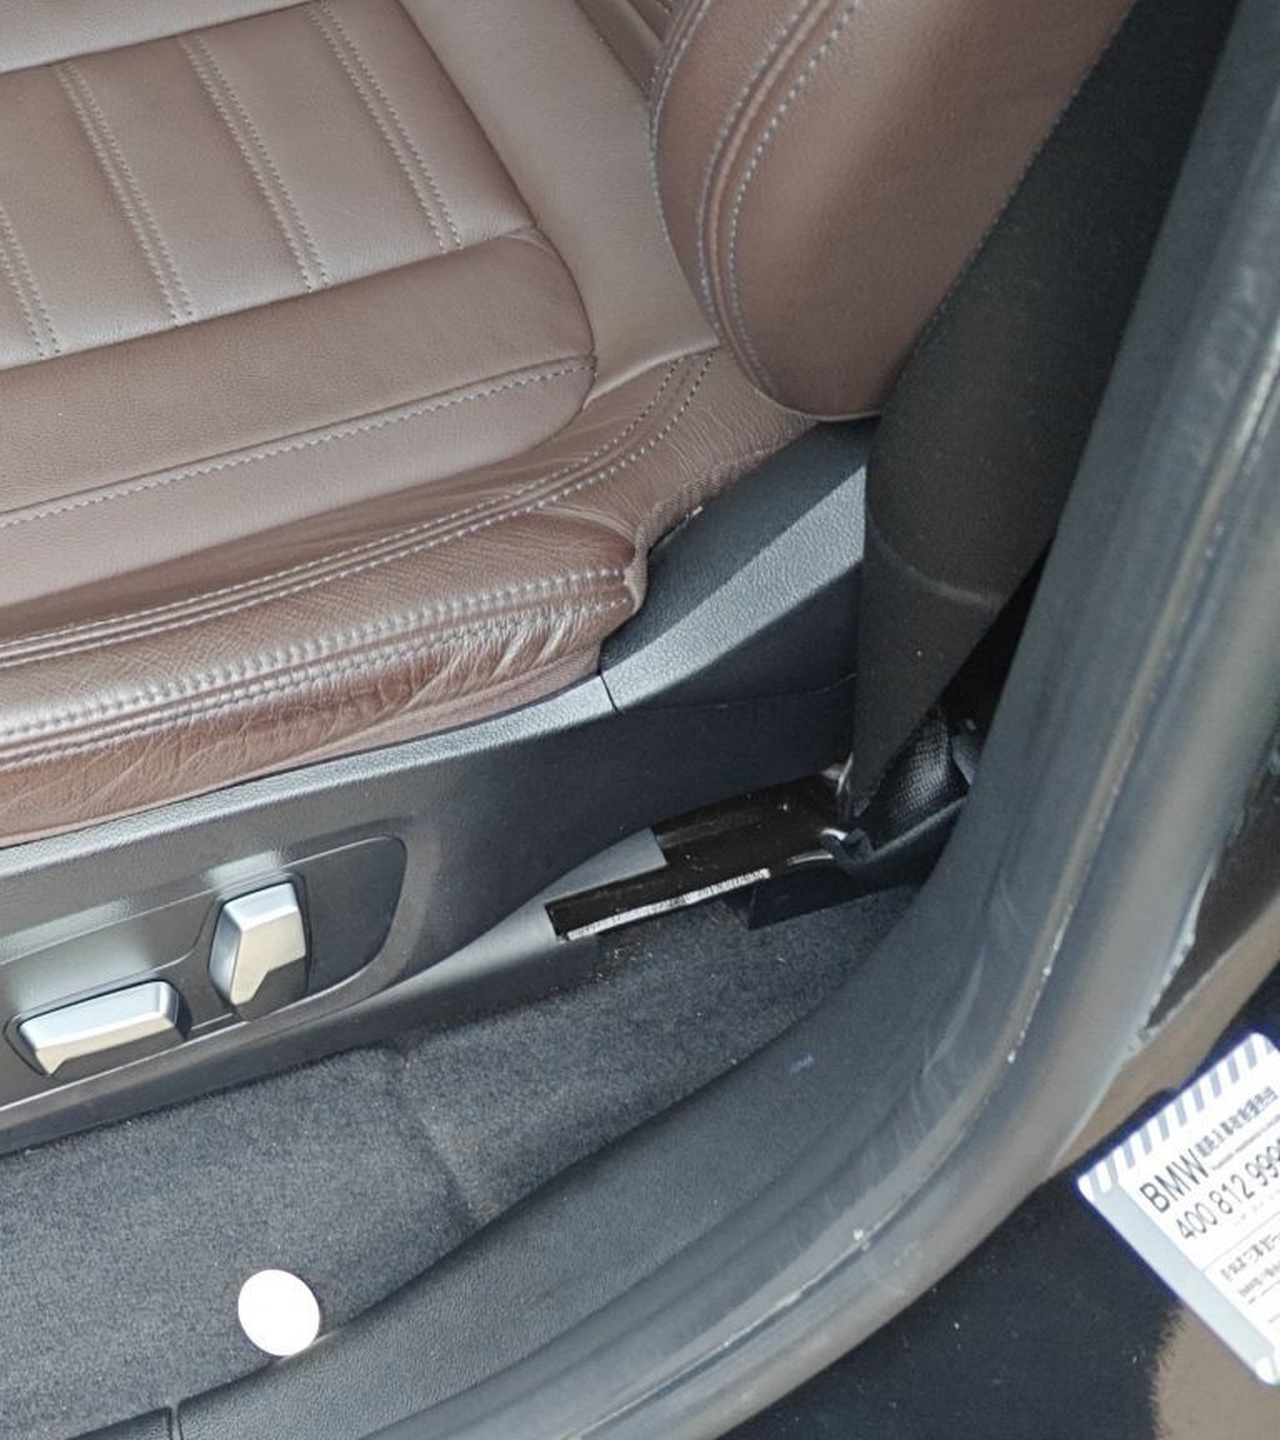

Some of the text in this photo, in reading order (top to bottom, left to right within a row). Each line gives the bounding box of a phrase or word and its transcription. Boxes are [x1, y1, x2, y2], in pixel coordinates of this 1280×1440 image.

[1139, 1146, 1209, 1214] BMW
[1177, 1202, 1218, 1240] 400
[1209, 1174, 1255, 1214] 812
[1245, 1137, 1280, 1187] 999
